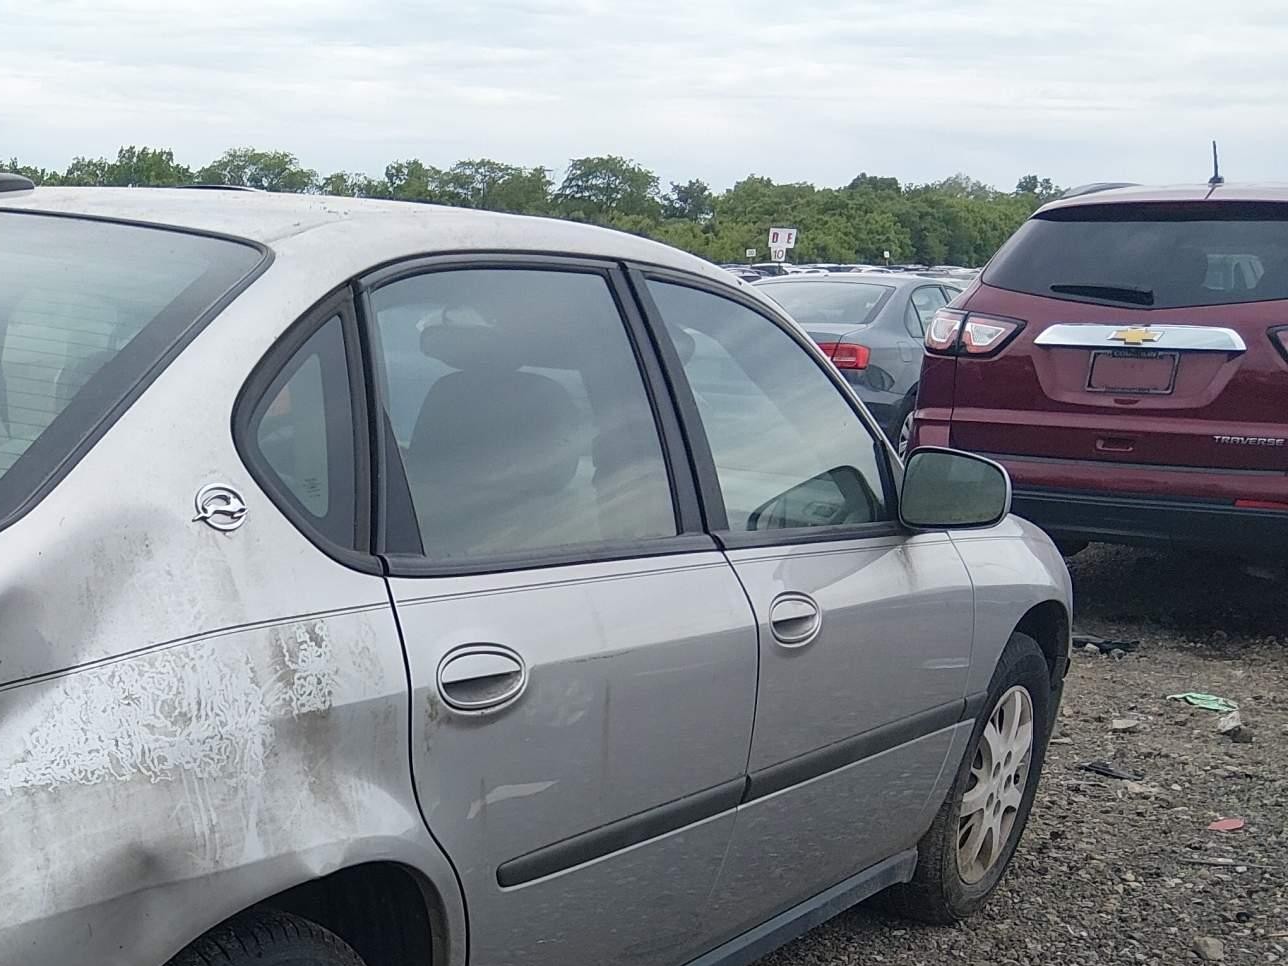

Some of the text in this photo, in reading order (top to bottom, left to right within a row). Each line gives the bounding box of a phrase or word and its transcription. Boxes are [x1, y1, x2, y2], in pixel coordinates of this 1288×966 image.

[772, 232, 793, 244] D E
[773, 249, 784, 260] 10
[1214, 435, 1285, 446] TRAVERSE
